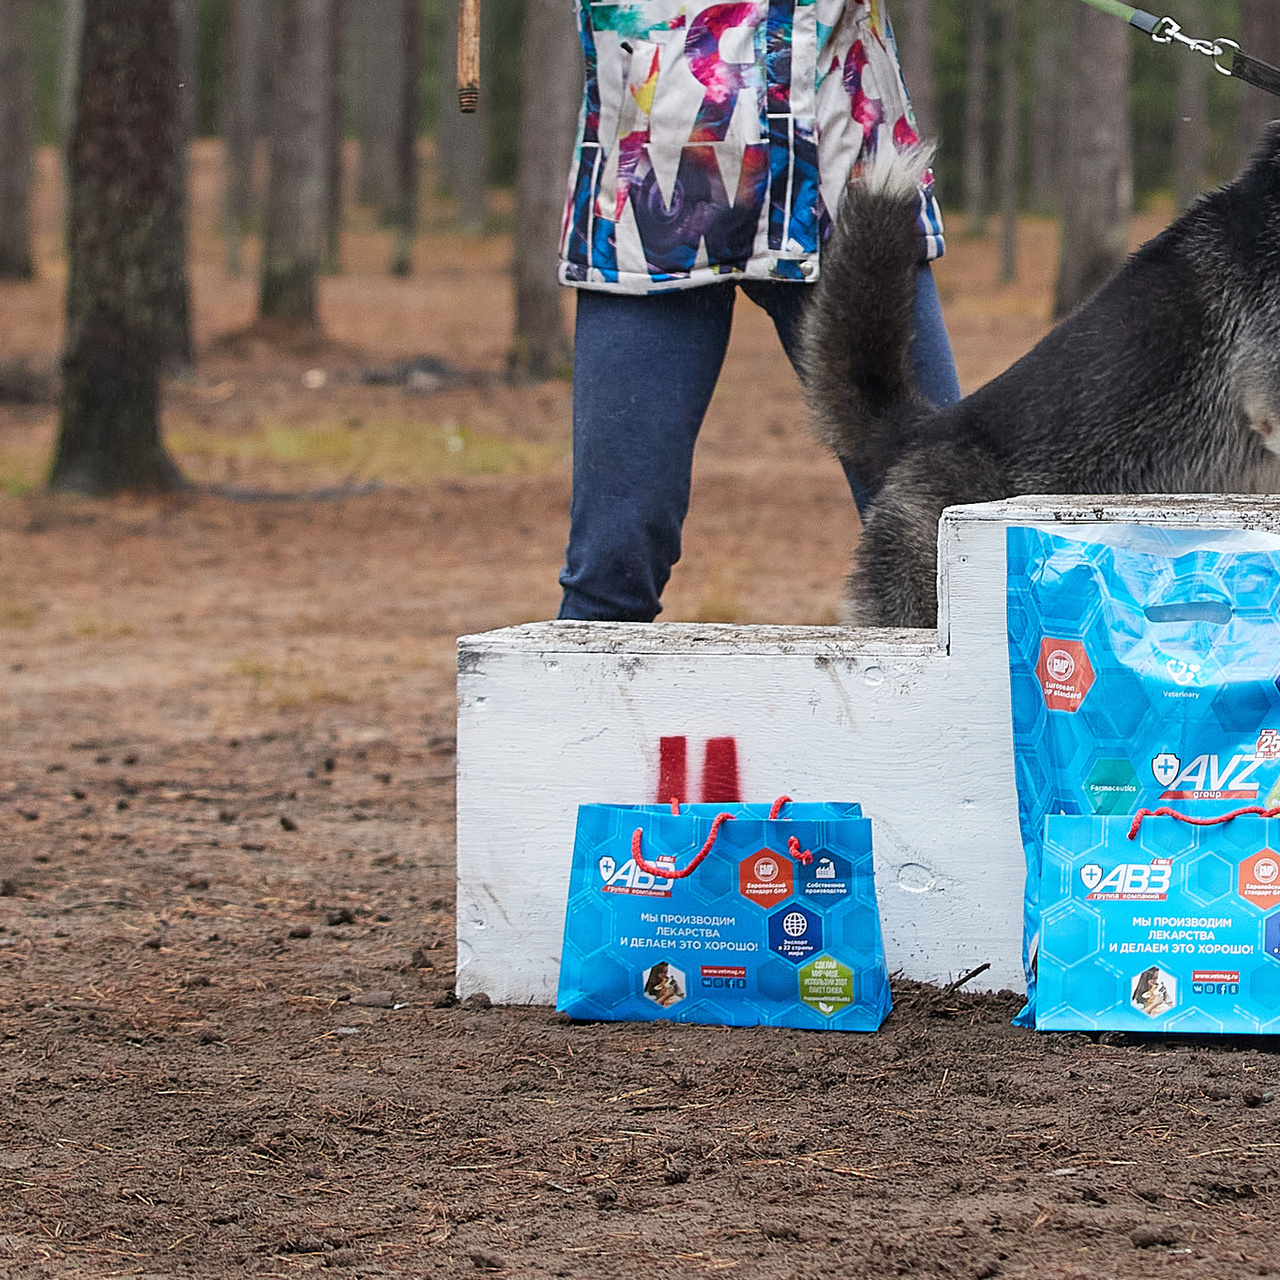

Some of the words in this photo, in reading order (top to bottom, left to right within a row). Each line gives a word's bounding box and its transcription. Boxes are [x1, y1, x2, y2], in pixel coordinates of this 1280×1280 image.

[1045, 681, 1075, 692] European
[1053, 689, 1082, 700] standard
[1162, 690, 1200, 699] Veterinary
[1167, 754, 1265, 791] AVZ
[1089, 783, 1136, 793] Farmaceutics
[1193, 789, 1222, 799] group
[606, 886, 630, 895] группа
[640, 912, 658, 922] МЫ
[660, 914, 736, 926] ПРОИЗВОДИМ
[1132, 916, 1151, 927] МЫ
[1153, 917, 1232, 929] ПРОИЗВОДИМ
[655, 926, 721, 938] ЛЕКАРСТВА
[1147, 930, 1216, 941] ЛЕКАРСТВА
[620, 937, 629, 946] И
[630, 938, 676, 949] ДЕЛАЕМ
[679, 940, 702, 950] ЭТО
[704, 941, 759, 952] ХОРОШО!
[1109, 943, 1118, 952] И
[1119, 943, 1169, 954] ДЕЛАЕМ
[1171, 943, 1195, 954] ЭТО
[1197, 944, 1254, 955] ХОРОШО!
